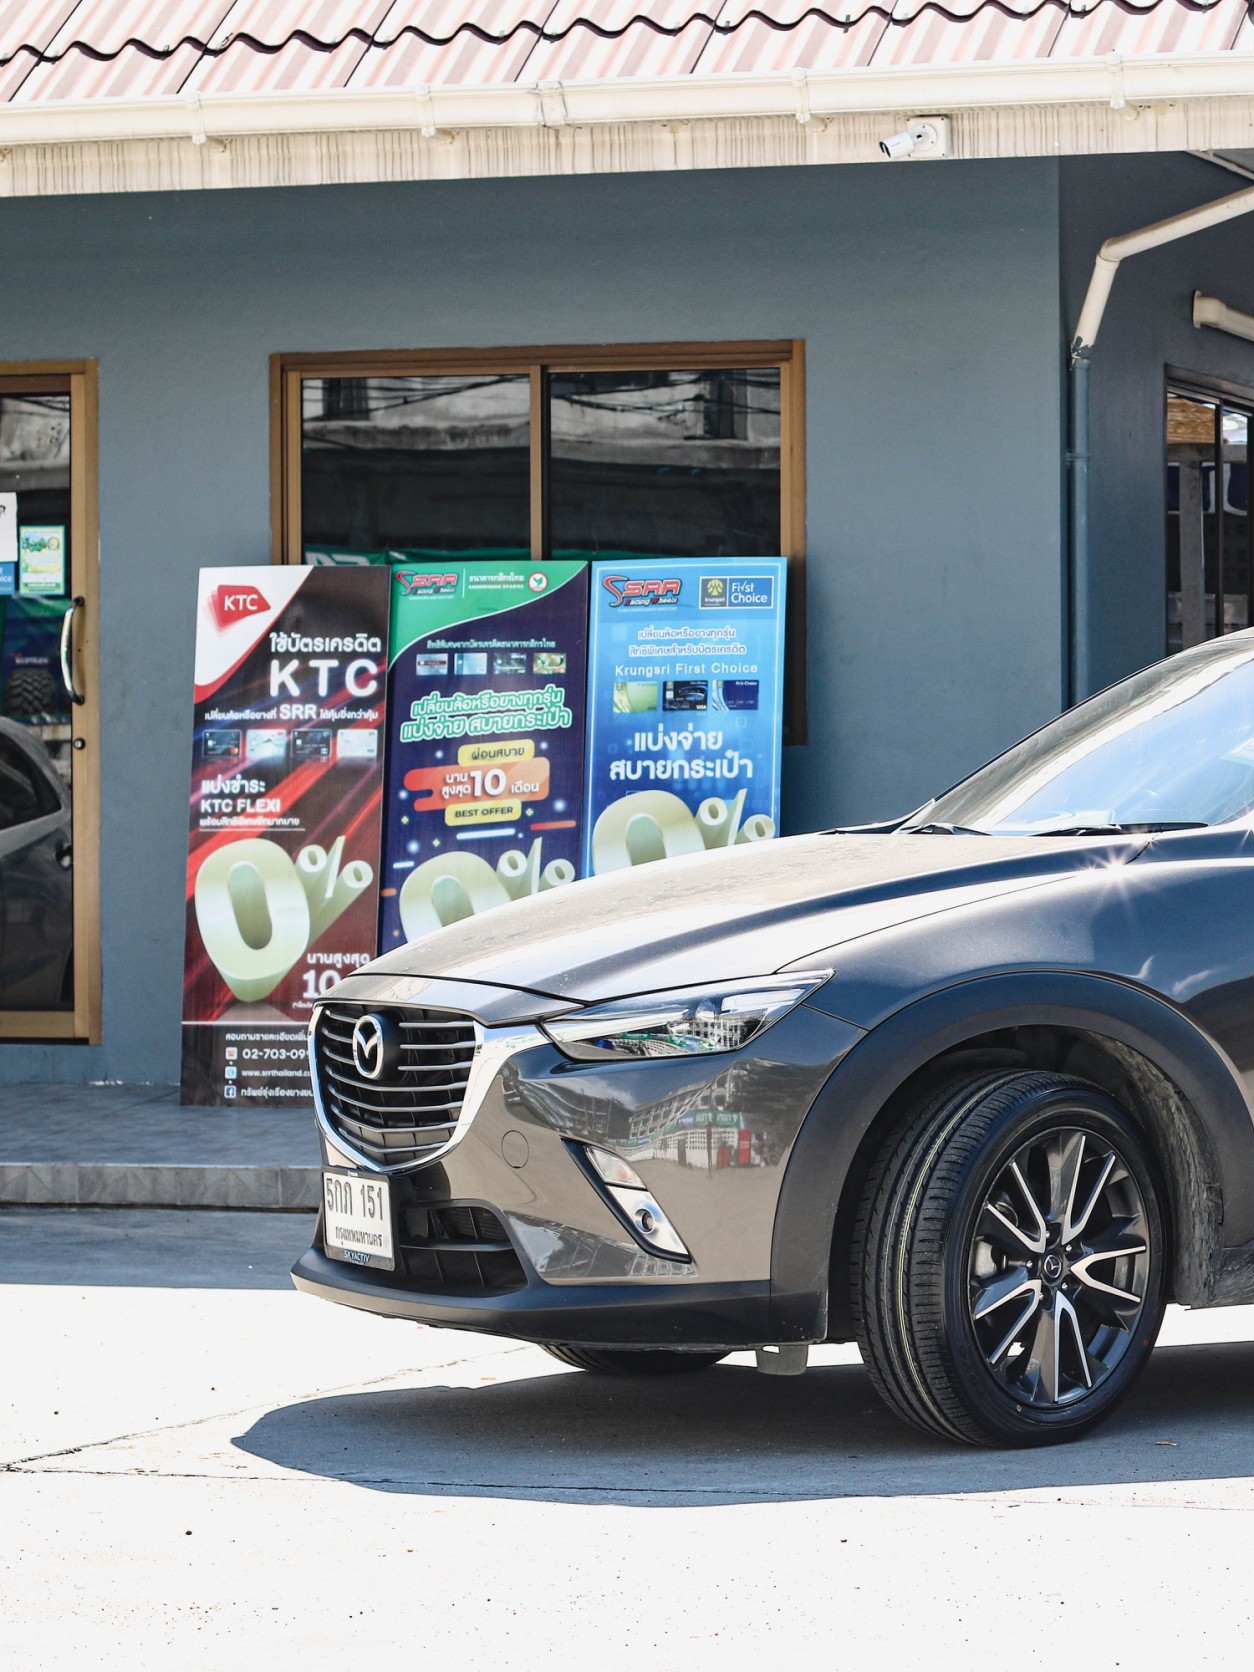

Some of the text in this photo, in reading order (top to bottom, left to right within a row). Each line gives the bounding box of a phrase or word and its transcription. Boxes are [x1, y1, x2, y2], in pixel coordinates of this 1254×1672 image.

[224, 595, 259, 611] KTC
[731, 592, 768, 604] Choice
[270, 632, 381, 653] ใช้บัตรเครดิต
[270, 659, 379, 697] KTC
[614, 662, 758, 678] Krungsri First Choice
[412, 686, 564, 718] เปลี่ยนล้อหรือยางทุกรุ่น
[279, 704, 317, 720] SRR
[402, 707, 571, 741] แบ่งจ่าย สบายกระเป๋า
[634, 723, 724, 752] แบ่งจ่าย
[471, 746, 525, 761] ผ่อนสบาย
[609, 749, 753, 781] สบายกระเป๋า
[201, 774, 266, 794] แบ่งชำระ
[445, 772, 469, 784] นาน
[470, 768, 540, 797] 10 เดือน
[442, 784, 471, 799] สูงสุด
[201, 798, 281, 813] KTC FLEXI
[454, 806, 514, 819] BEST OFFER
[195, 835, 374, 985] 0%
[360, 1184, 383, 1221] 151
[343, 1249, 370, 1263] SKYACTIV
